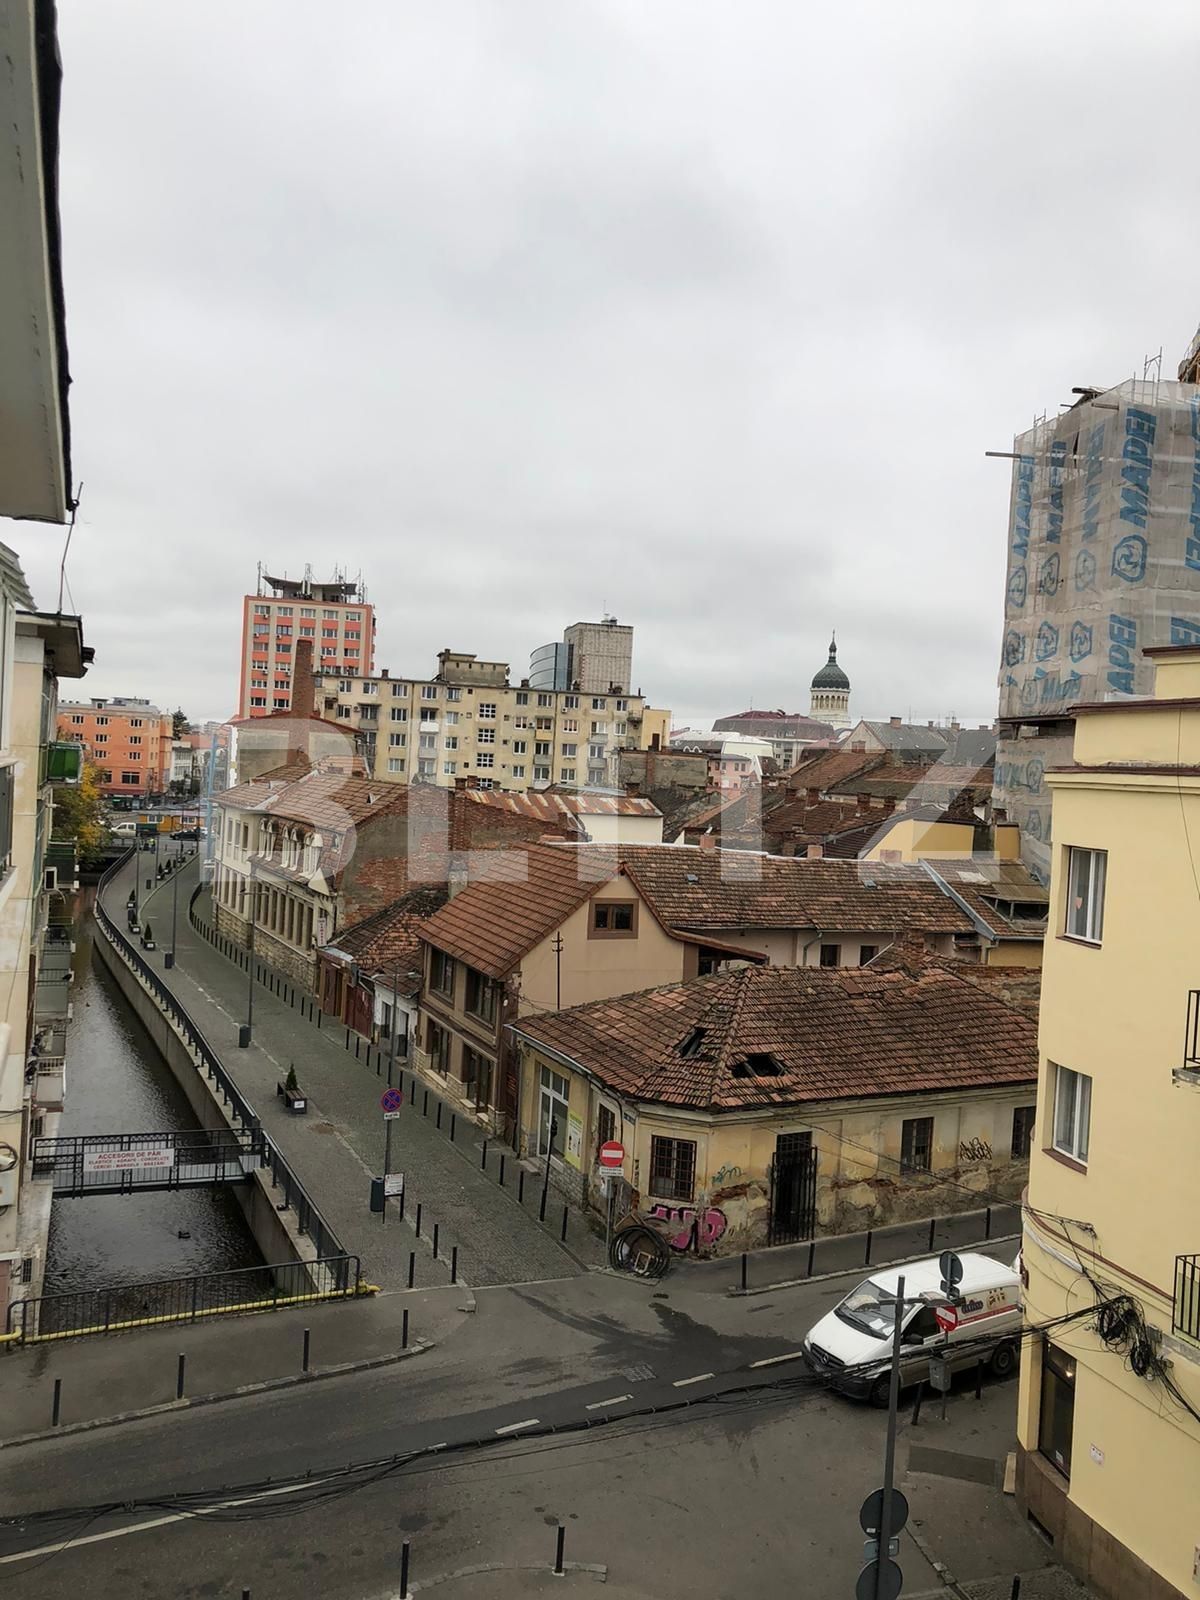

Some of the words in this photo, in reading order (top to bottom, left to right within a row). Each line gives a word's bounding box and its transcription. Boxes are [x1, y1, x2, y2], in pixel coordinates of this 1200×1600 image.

[1012, 454, 1035, 560] MAPEI
[1119, 407, 1157, 528] MAPEI
[1107, 613, 1137, 694] APEI
